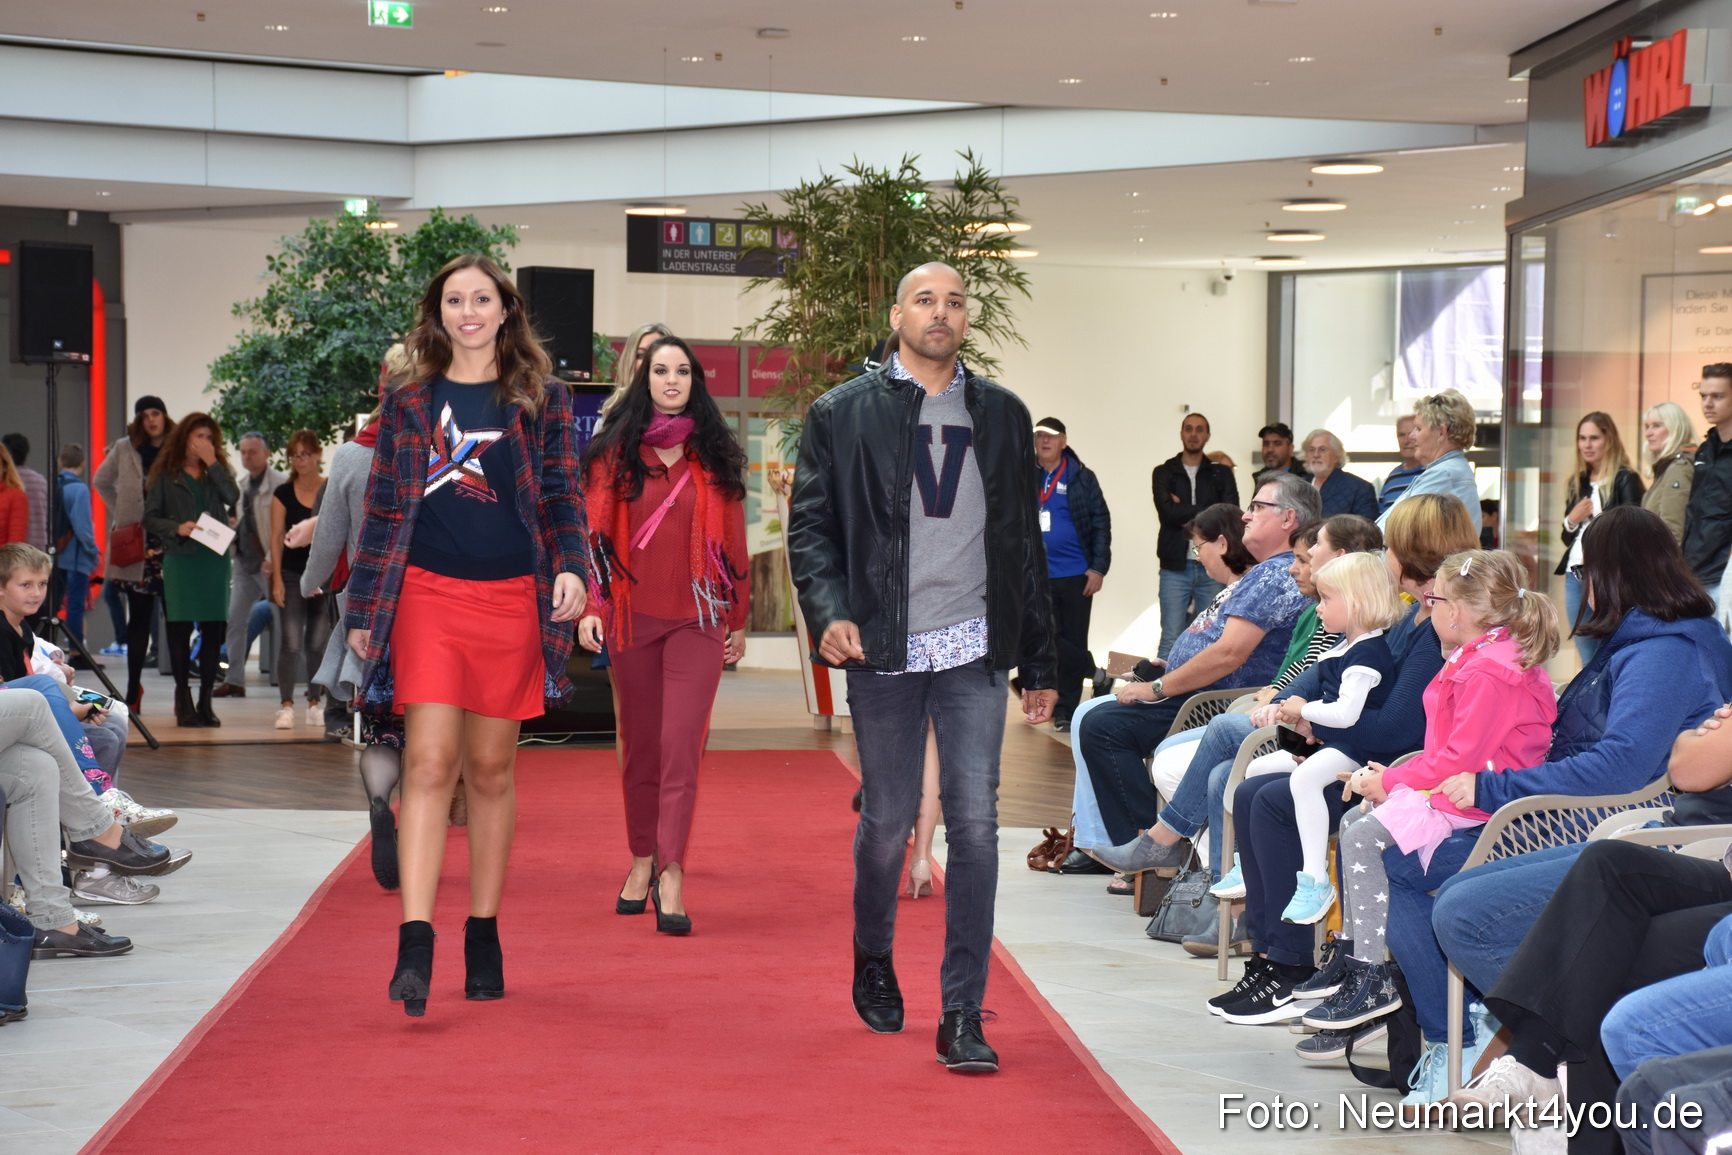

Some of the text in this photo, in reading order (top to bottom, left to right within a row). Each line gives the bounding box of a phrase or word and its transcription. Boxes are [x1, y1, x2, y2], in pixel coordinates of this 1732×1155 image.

[1584, 29, 1691, 147] WÖHRL
[662, 248, 737, 260] IN DER UNTEREN
[662, 261, 736, 273] LADENSTRASSE
[1711, 302, 1728, 314] Sie
[914, 424, 972, 518] V
